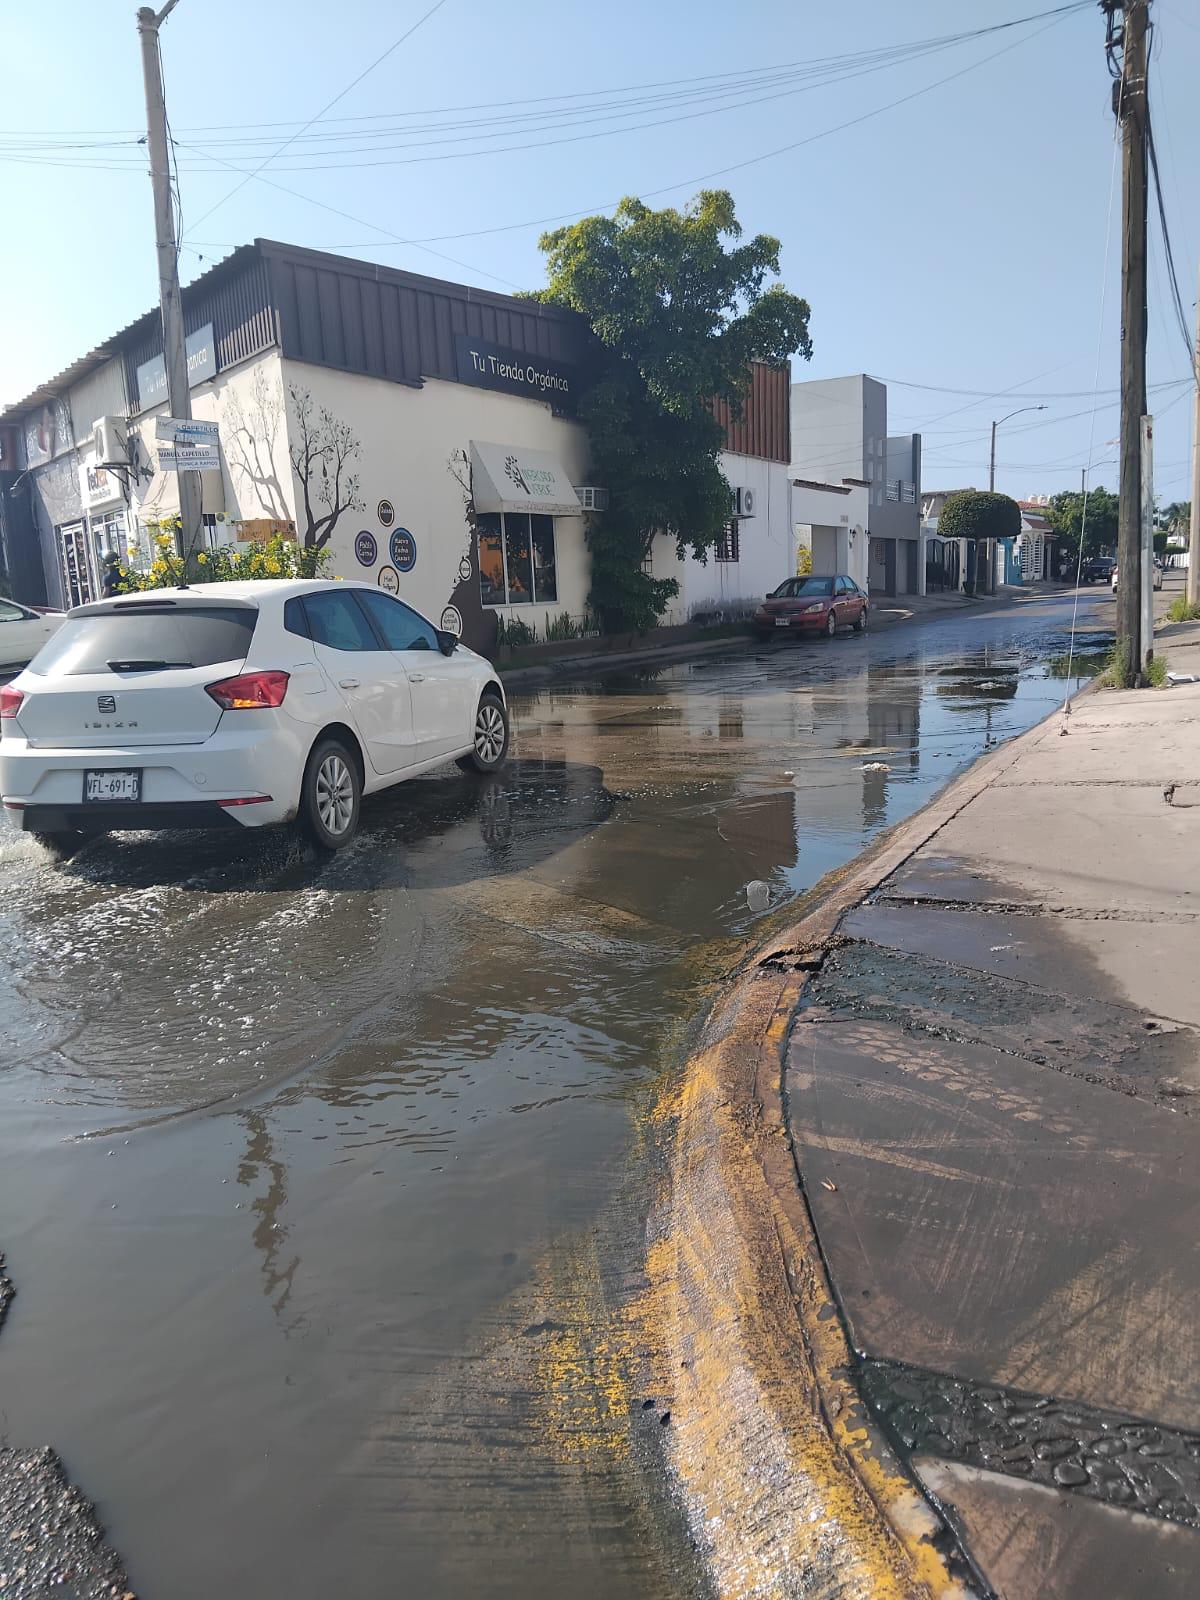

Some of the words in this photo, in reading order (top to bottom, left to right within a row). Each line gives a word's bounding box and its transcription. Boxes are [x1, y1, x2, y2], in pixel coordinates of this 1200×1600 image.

[470, 351, 486, 373] Tu
[488, 355, 524, 381] Tienda
[526, 366, 569, 392] Orgánica
[159, 450, 181, 458] MANUEL
[521, 467, 556, 483] MERCADO
[531, 483, 556, 497] VERDE
[84, 721, 138, 729] IBIZA
[87, 779, 138, 793] VFL-691-D
